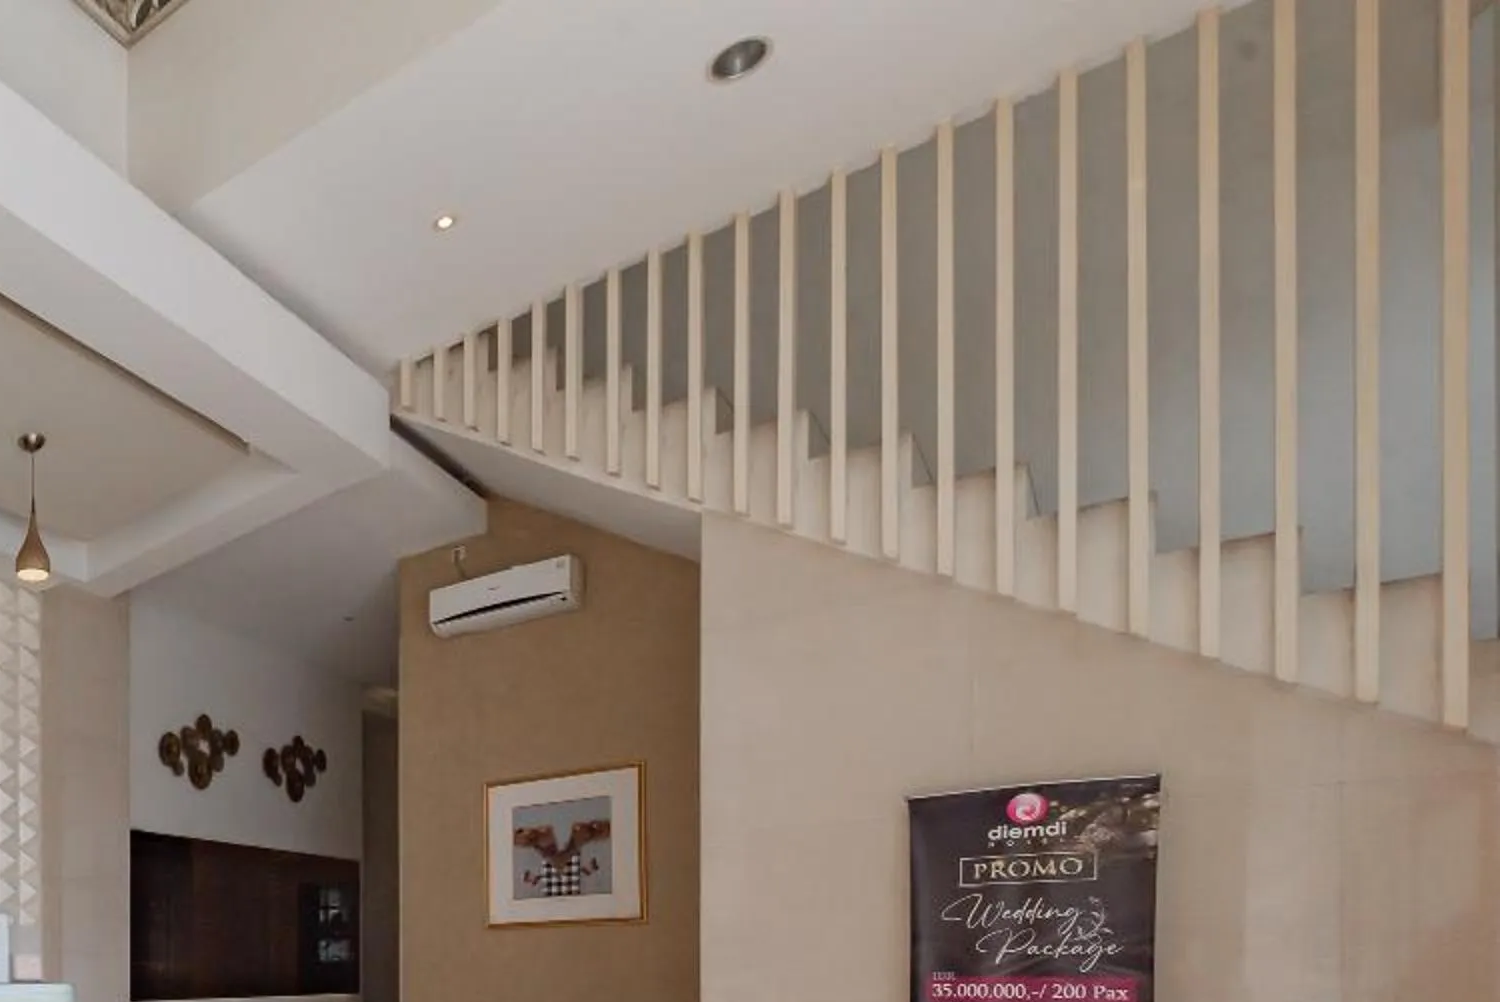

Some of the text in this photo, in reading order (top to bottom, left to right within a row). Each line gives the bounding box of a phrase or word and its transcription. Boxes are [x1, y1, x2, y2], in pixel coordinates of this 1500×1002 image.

[973, 857, 1083, 880] PROMO
[941, 893, 1083, 937] Wedding
[975, 927, 1125, 973] Package
[1052, 983, 1087, 1000] 200
[1093, 984, 1129, 1001] Pax
